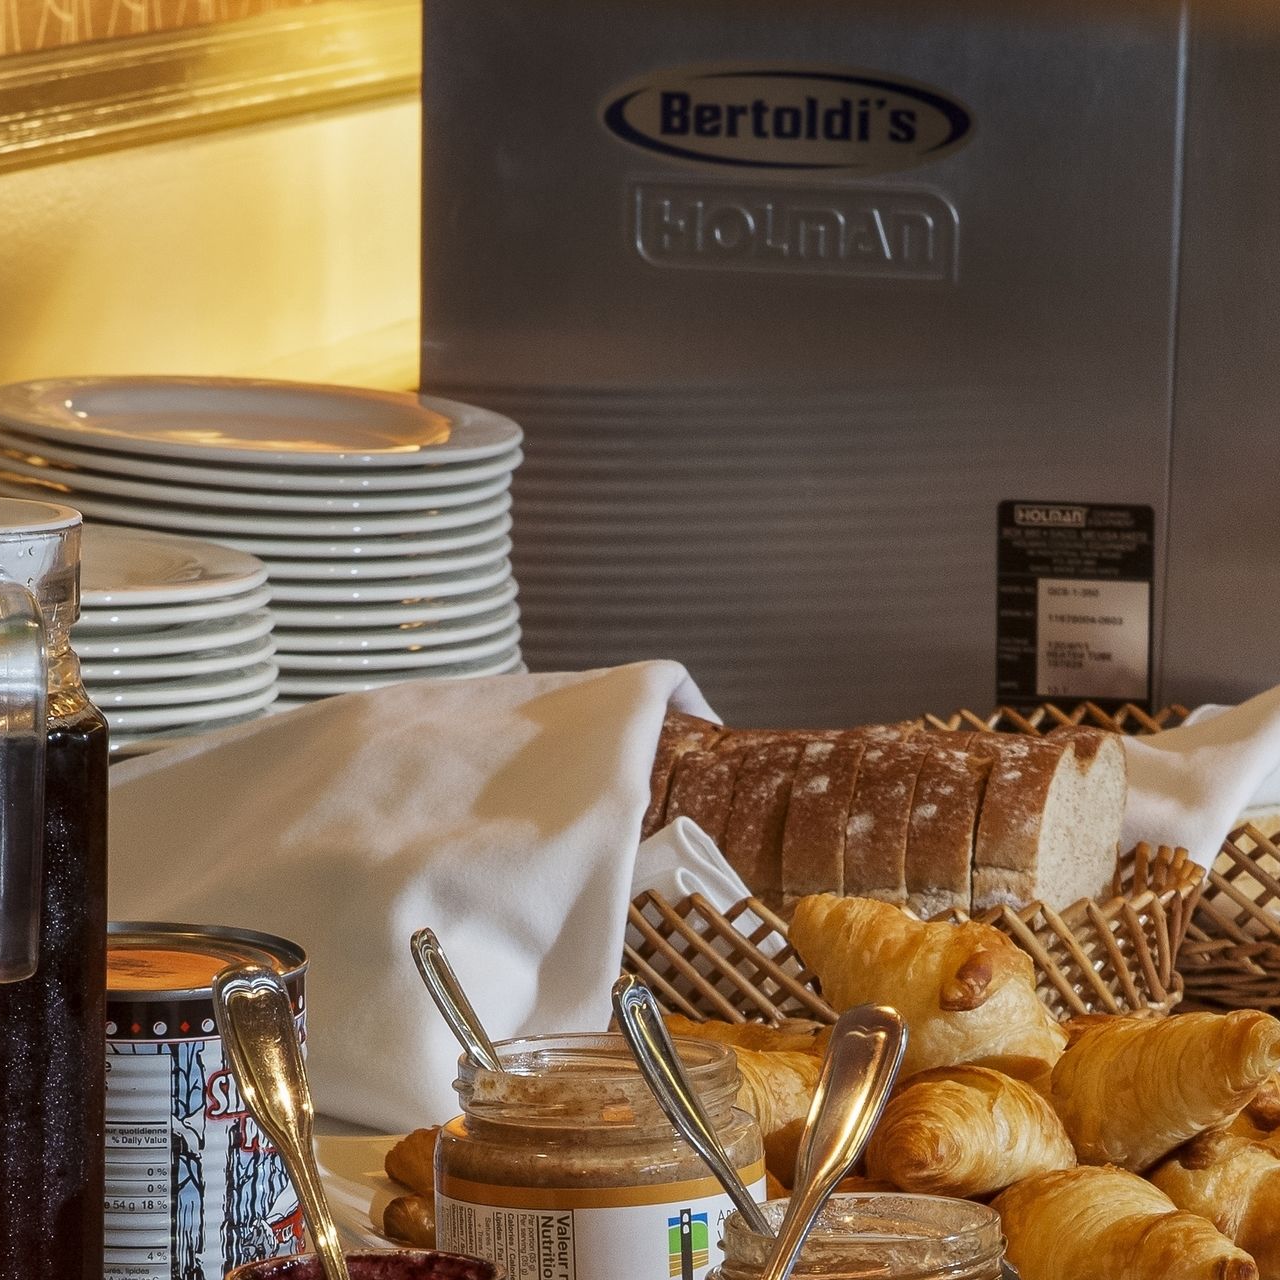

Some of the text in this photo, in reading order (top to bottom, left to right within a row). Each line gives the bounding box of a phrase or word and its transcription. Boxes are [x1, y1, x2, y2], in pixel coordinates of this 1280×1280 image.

[659, 91, 917, 143] Bertoldi's
[118, 1127, 168, 1136] quotidienne
[121, 1136, 143, 1146] Daily
[144, 1136, 168, 1144] Value
[147, 1168, 168, 1177] 0 %
[147, 1184, 168, 1193] 0 %
[112, 1200, 126, 1209] 54
[141, 1200, 154, 1209] 18
[157, 1200, 168, 1210] %
[507, 1212, 515, 1247] Calories
[556, 1215, 571, 1270] Valeur
[147, 1251, 167, 1261] 4 %
